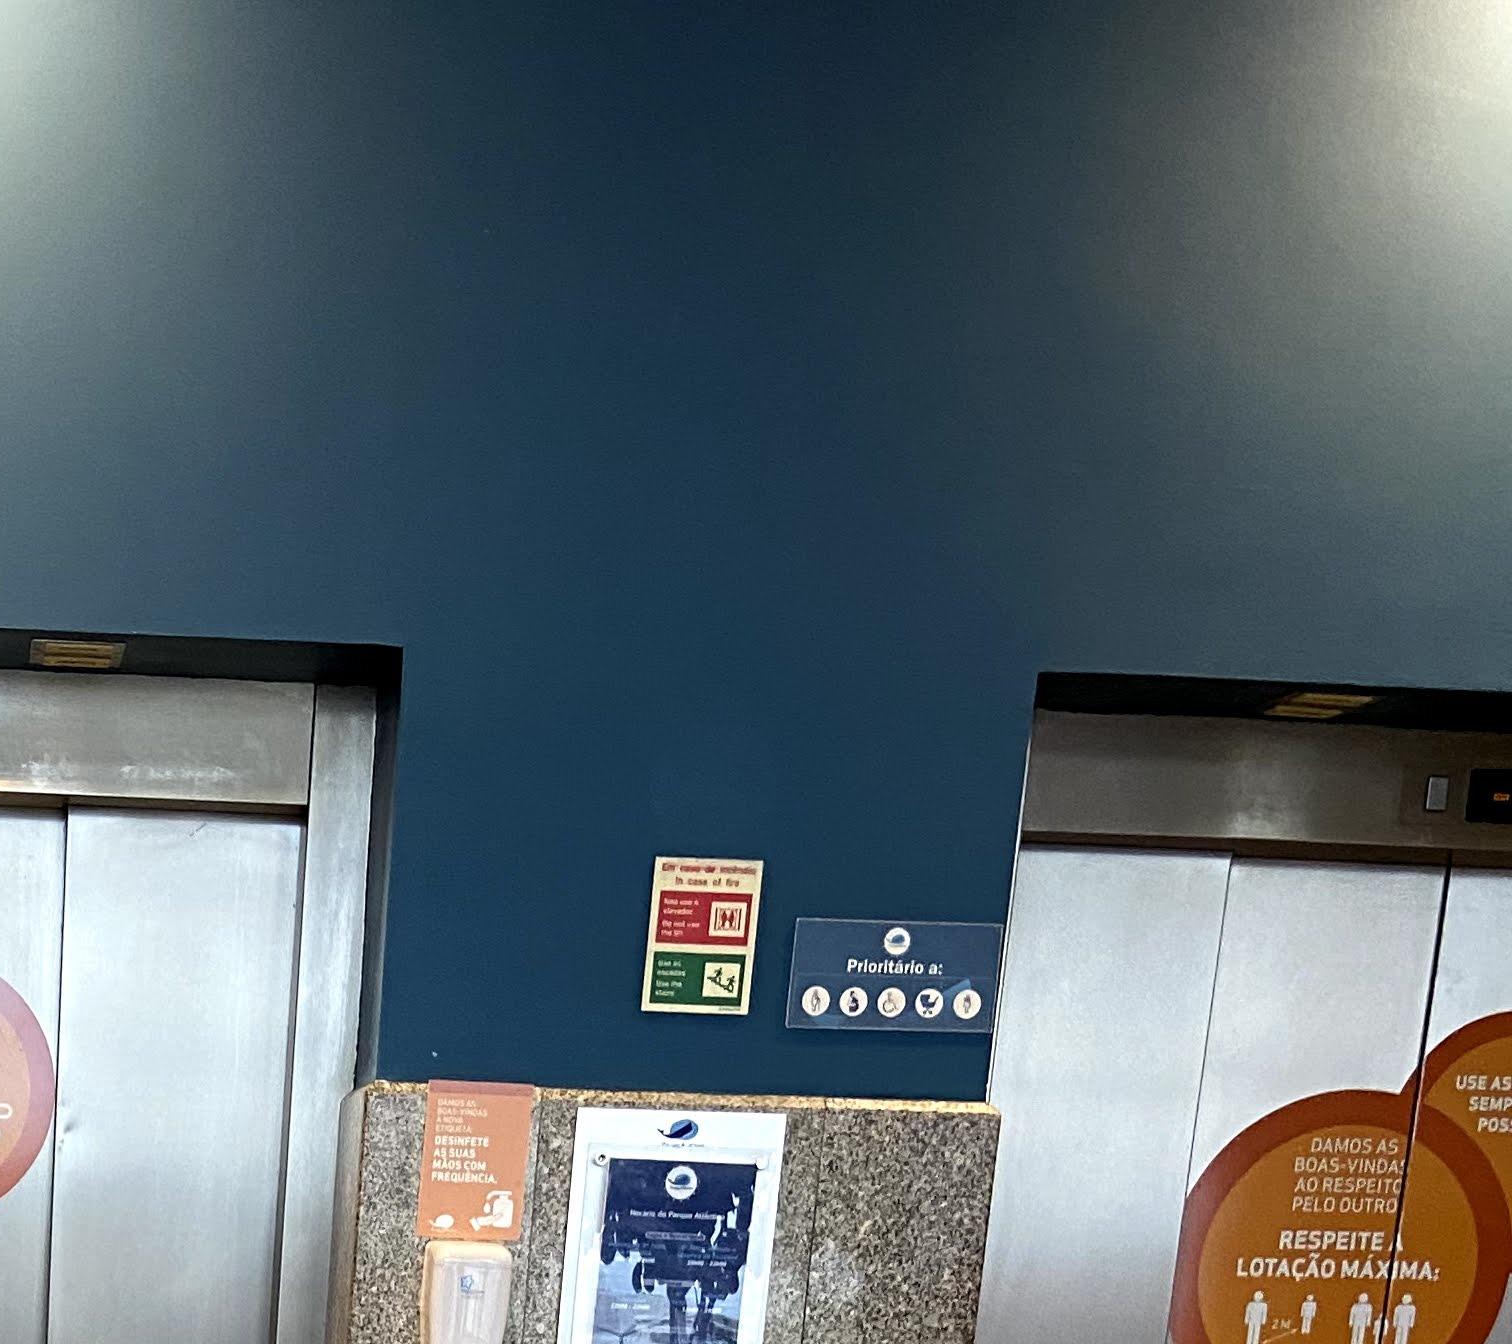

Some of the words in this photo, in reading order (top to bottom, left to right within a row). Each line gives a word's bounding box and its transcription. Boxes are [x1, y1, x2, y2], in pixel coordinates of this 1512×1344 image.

[847, 958, 924, 975] Prioritário
[929, 963, 943, 976] a:
[1456, 1074, 1487, 1090] USE
[434, 1136, 489, 1148] DESINFETE
[1311, 1138, 1371, 1154] DAMOS
[1377, 1138, 1399, 1155] AS
[433, 1148, 447, 1157] AS
[449, 1148, 476, 1158] SUAS
[432, 1157, 462, 1170] MÃOS
[464, 1160, 487, 1171] COM
[1294, 1177, 1319, 1193] AO
[1292, 1197, 1336, 1213] PELO
[1279, 1230, 1385, 1252] RESPEITE
[1236, 1252, 1336, 1282] LOTAÇÃO
